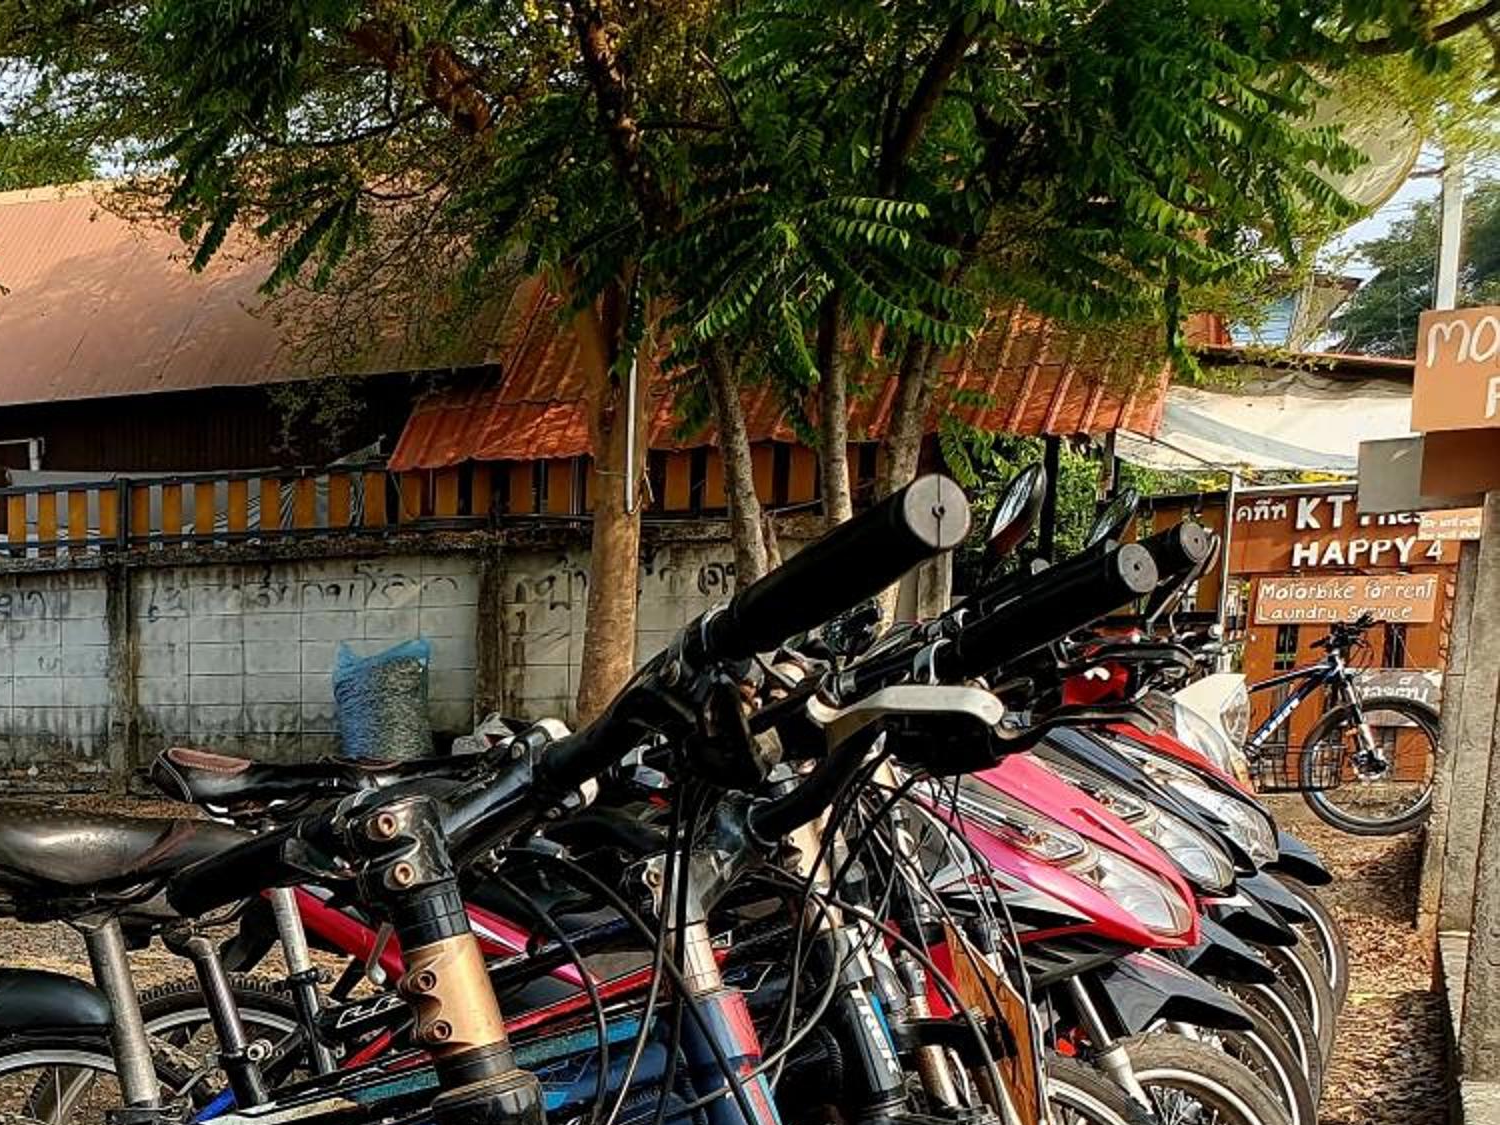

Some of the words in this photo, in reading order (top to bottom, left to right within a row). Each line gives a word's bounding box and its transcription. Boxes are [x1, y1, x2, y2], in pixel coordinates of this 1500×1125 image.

[1295, 496, 1351, 530] KT
[1292, 536, 1416, 566] HAPPY
[1261, 582, 1357, 600] Motorbike
[1364, 582, 1391, 599] for
[1396, 579, 1437, 599] rent
[1259, 604, 1338, 621] Laundry
